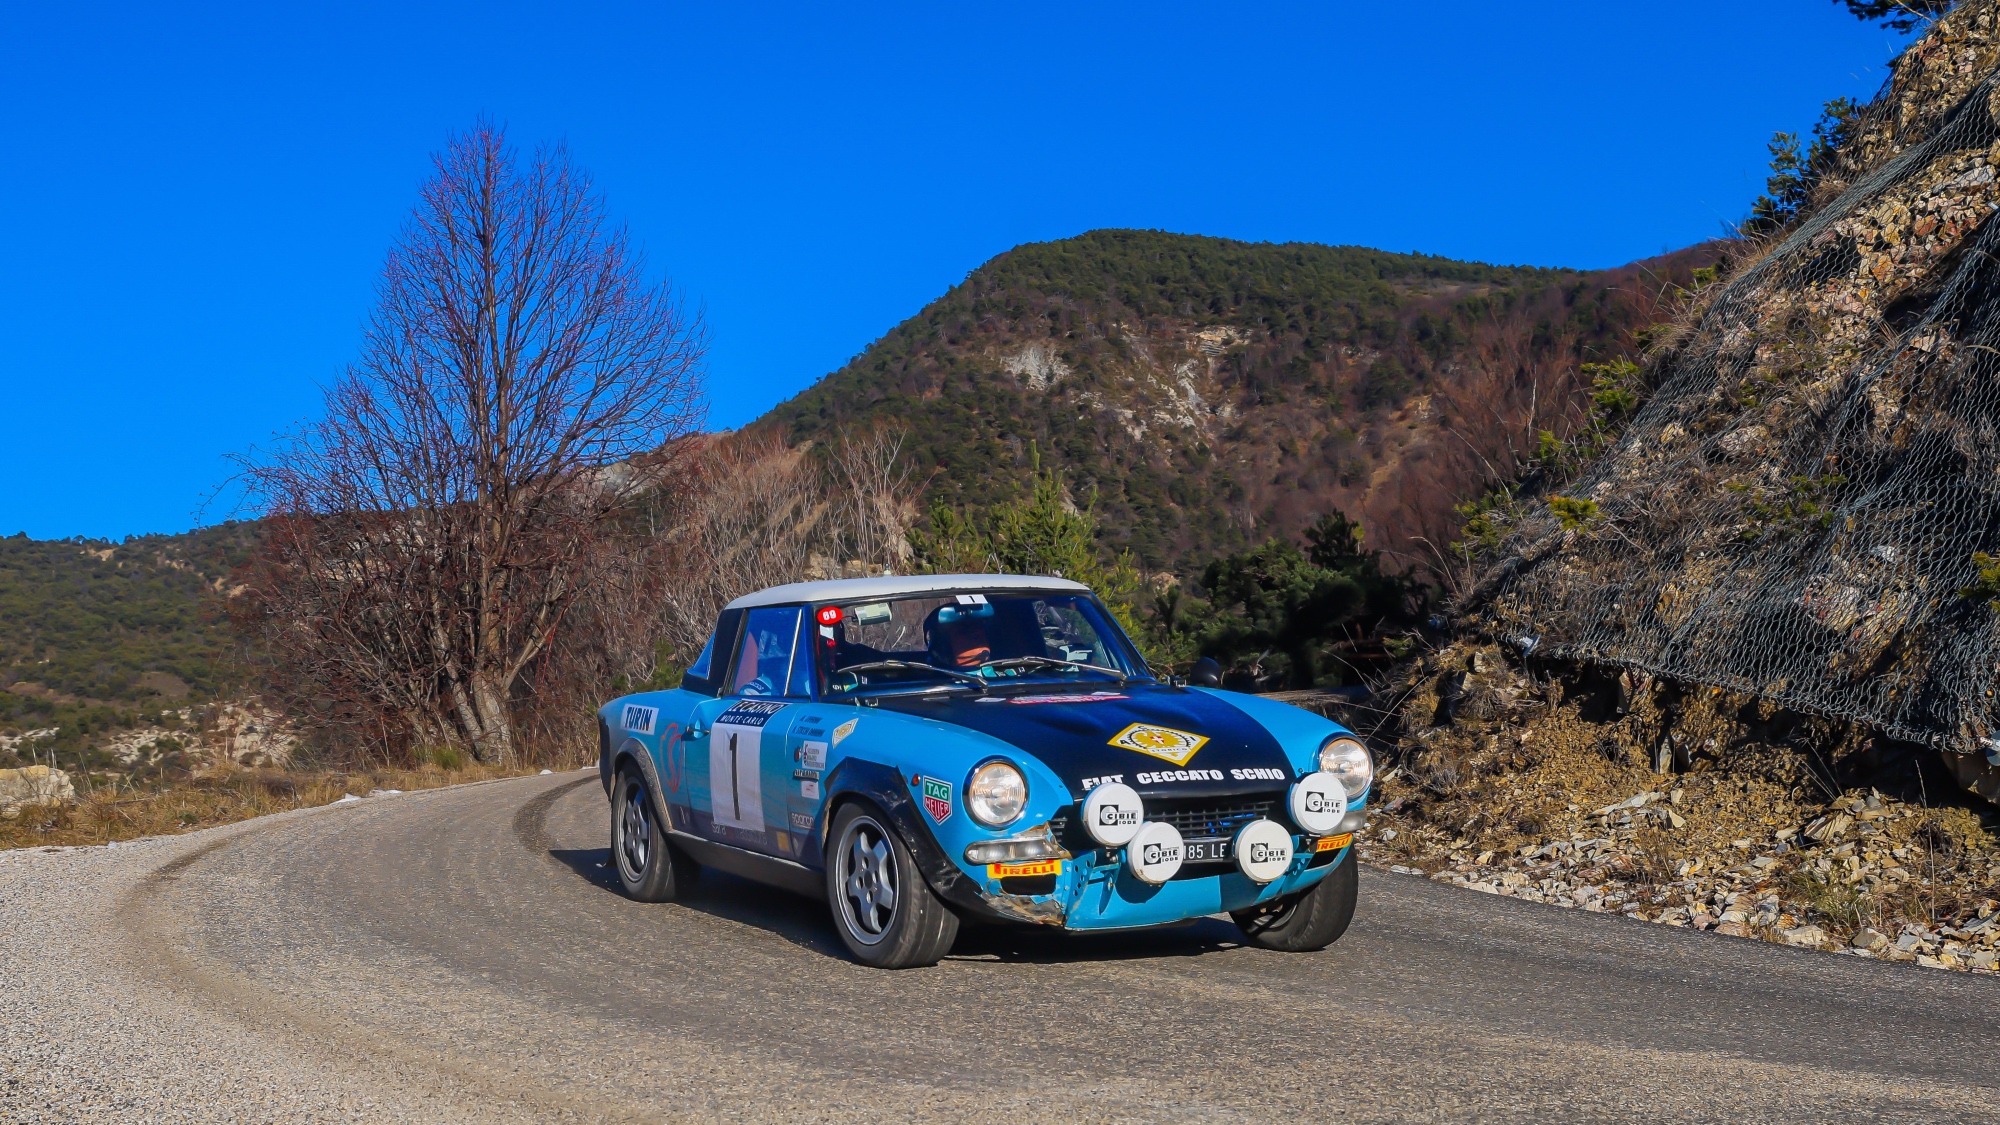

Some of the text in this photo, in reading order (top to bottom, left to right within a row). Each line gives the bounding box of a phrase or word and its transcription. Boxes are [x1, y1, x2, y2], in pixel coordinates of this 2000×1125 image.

[624, 706, 653, 732] TURIN
[740, 701, 783, 715] CASINO
[727, 732, 741, 821] 1
[1081, 767, 1286, 791] FIAT CECCATO SCHIO
[926, 782, 949, 799] TAG
[925, 796, 949, 820] HEUER
[994, 859, 1055, 875] PIRELLI
